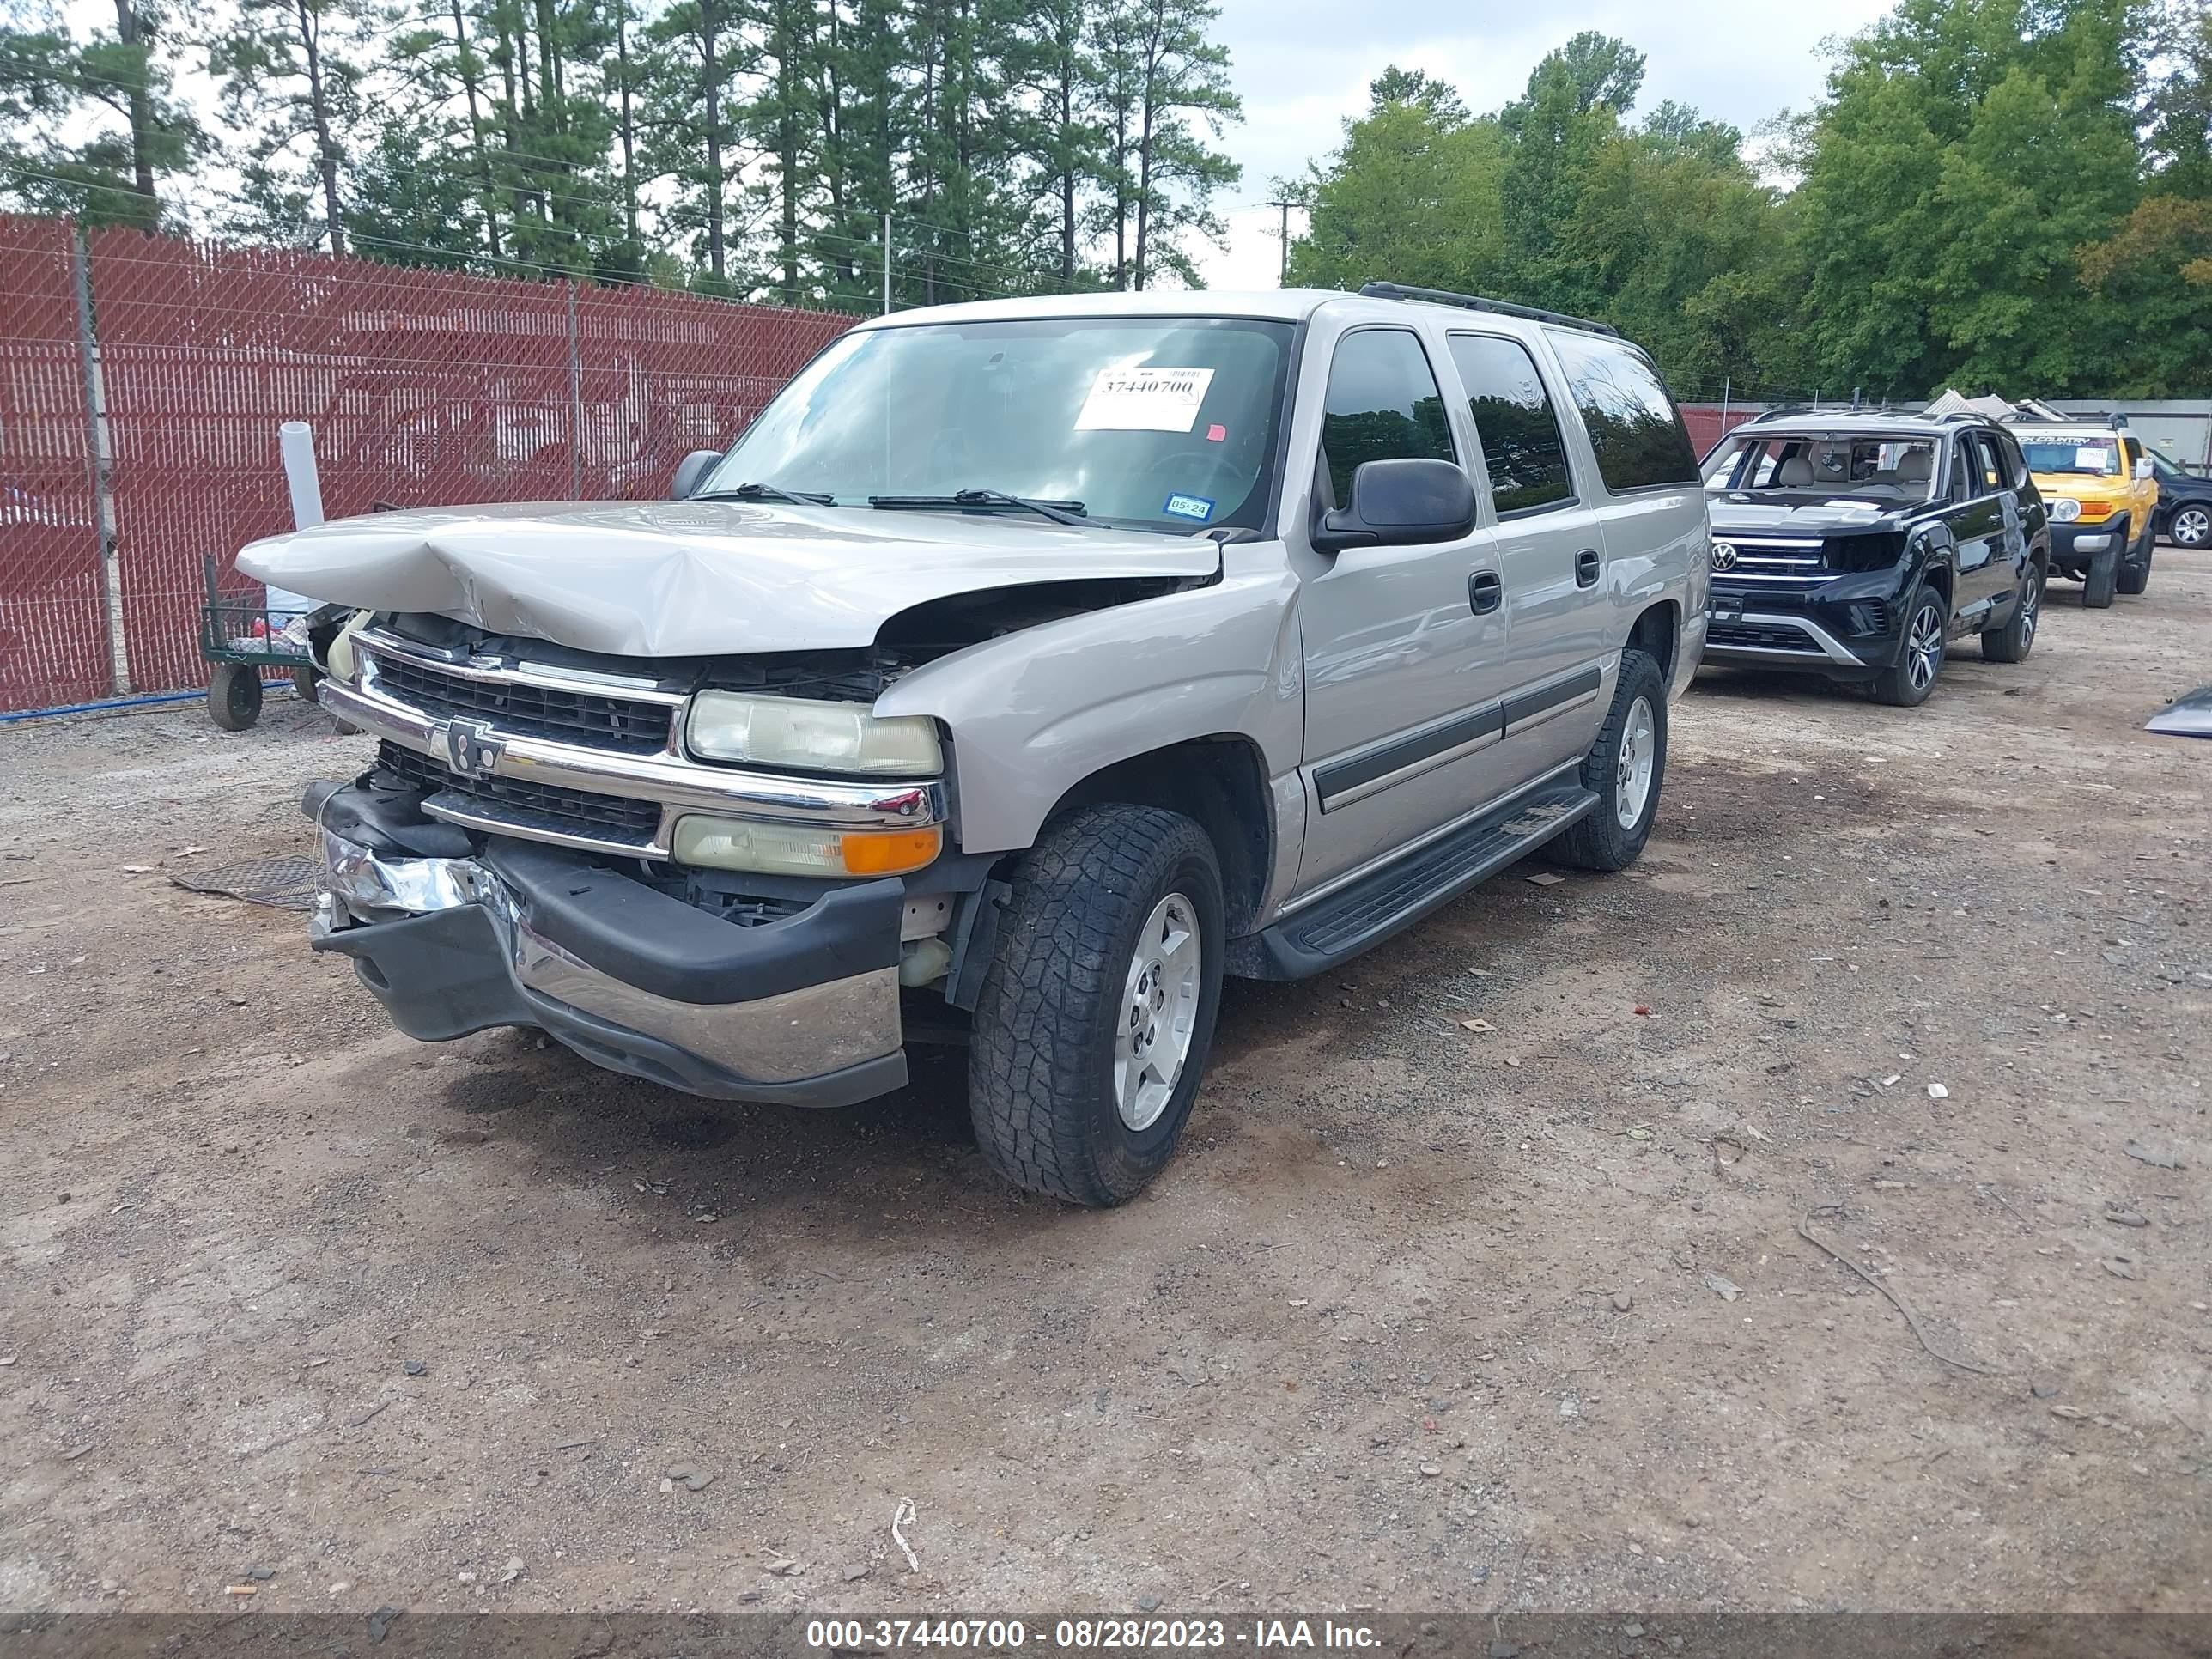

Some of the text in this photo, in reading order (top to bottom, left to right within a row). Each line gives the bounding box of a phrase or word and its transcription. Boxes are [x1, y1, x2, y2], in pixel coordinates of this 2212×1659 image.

[1103, 381, 1194, 393] 37440700
[1172, 500, 1206, 514] 05 24
